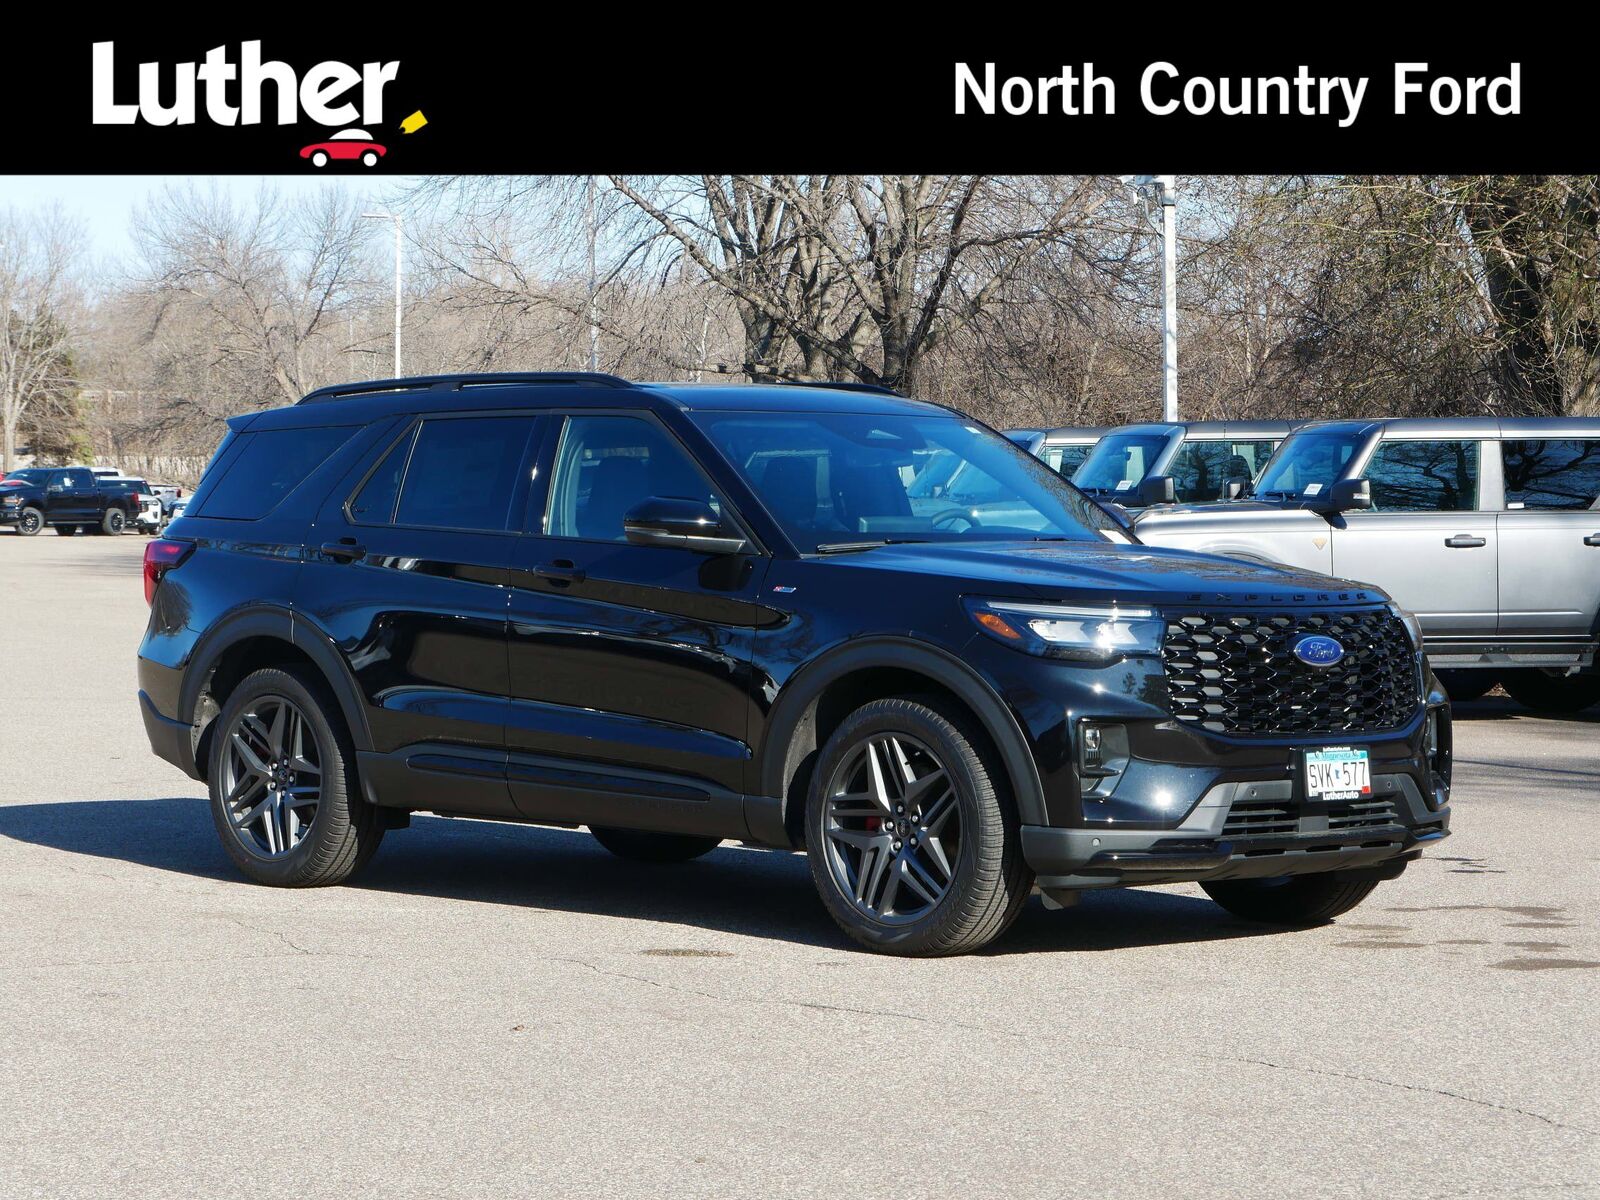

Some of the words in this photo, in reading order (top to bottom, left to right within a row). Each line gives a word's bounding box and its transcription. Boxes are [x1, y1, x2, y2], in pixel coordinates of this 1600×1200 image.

[1187, 593, 1366, 601] EXPLORER
[1308, 641, 1336, 659] Ford
[1309, 763, 1334, 789] SVK
[1342, 761, 1366, 786] 577
